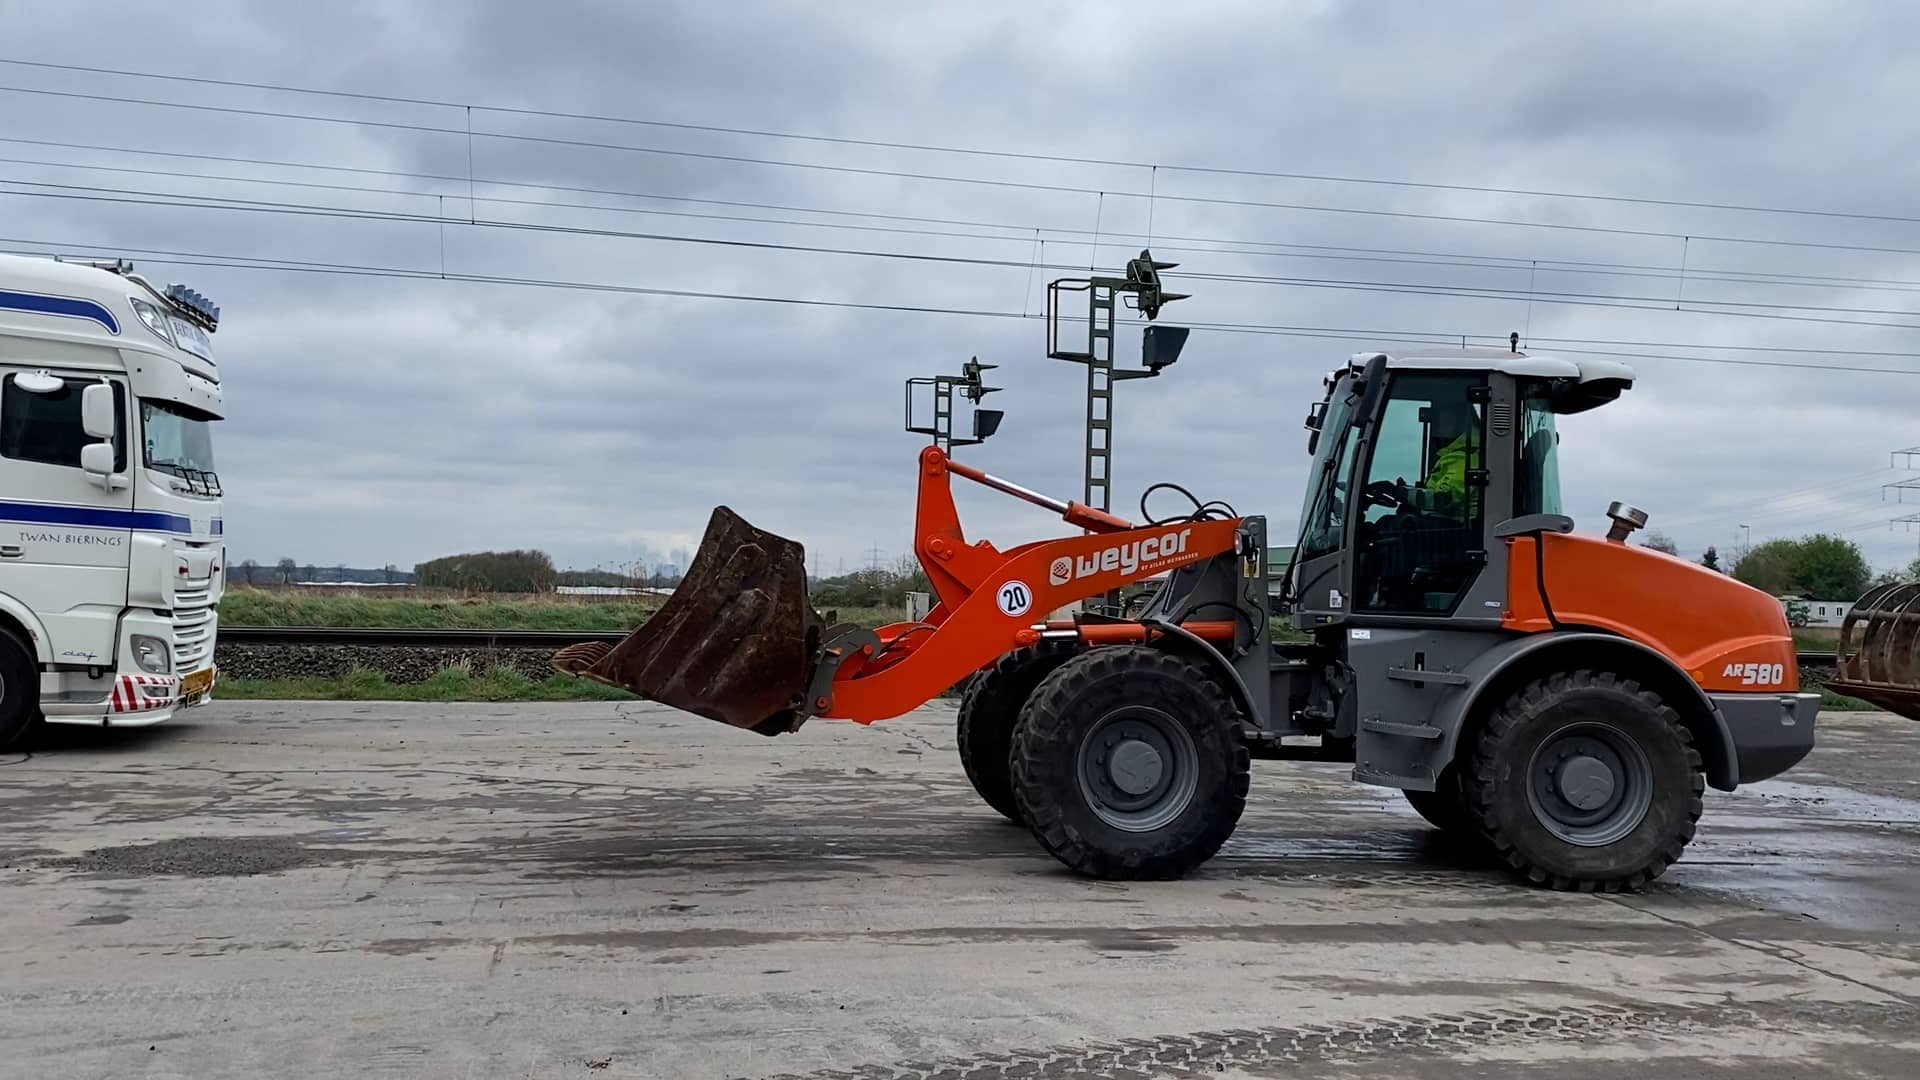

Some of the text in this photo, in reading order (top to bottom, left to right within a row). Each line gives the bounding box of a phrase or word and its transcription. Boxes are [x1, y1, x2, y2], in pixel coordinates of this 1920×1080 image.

[20, 532, 121, 546] TWAN BIERINGS
[1075, 528, 1191, 579] weycor
[1149, 559, 1165, 569] ATLAS
[1003, 586, 1027, 612] 20
